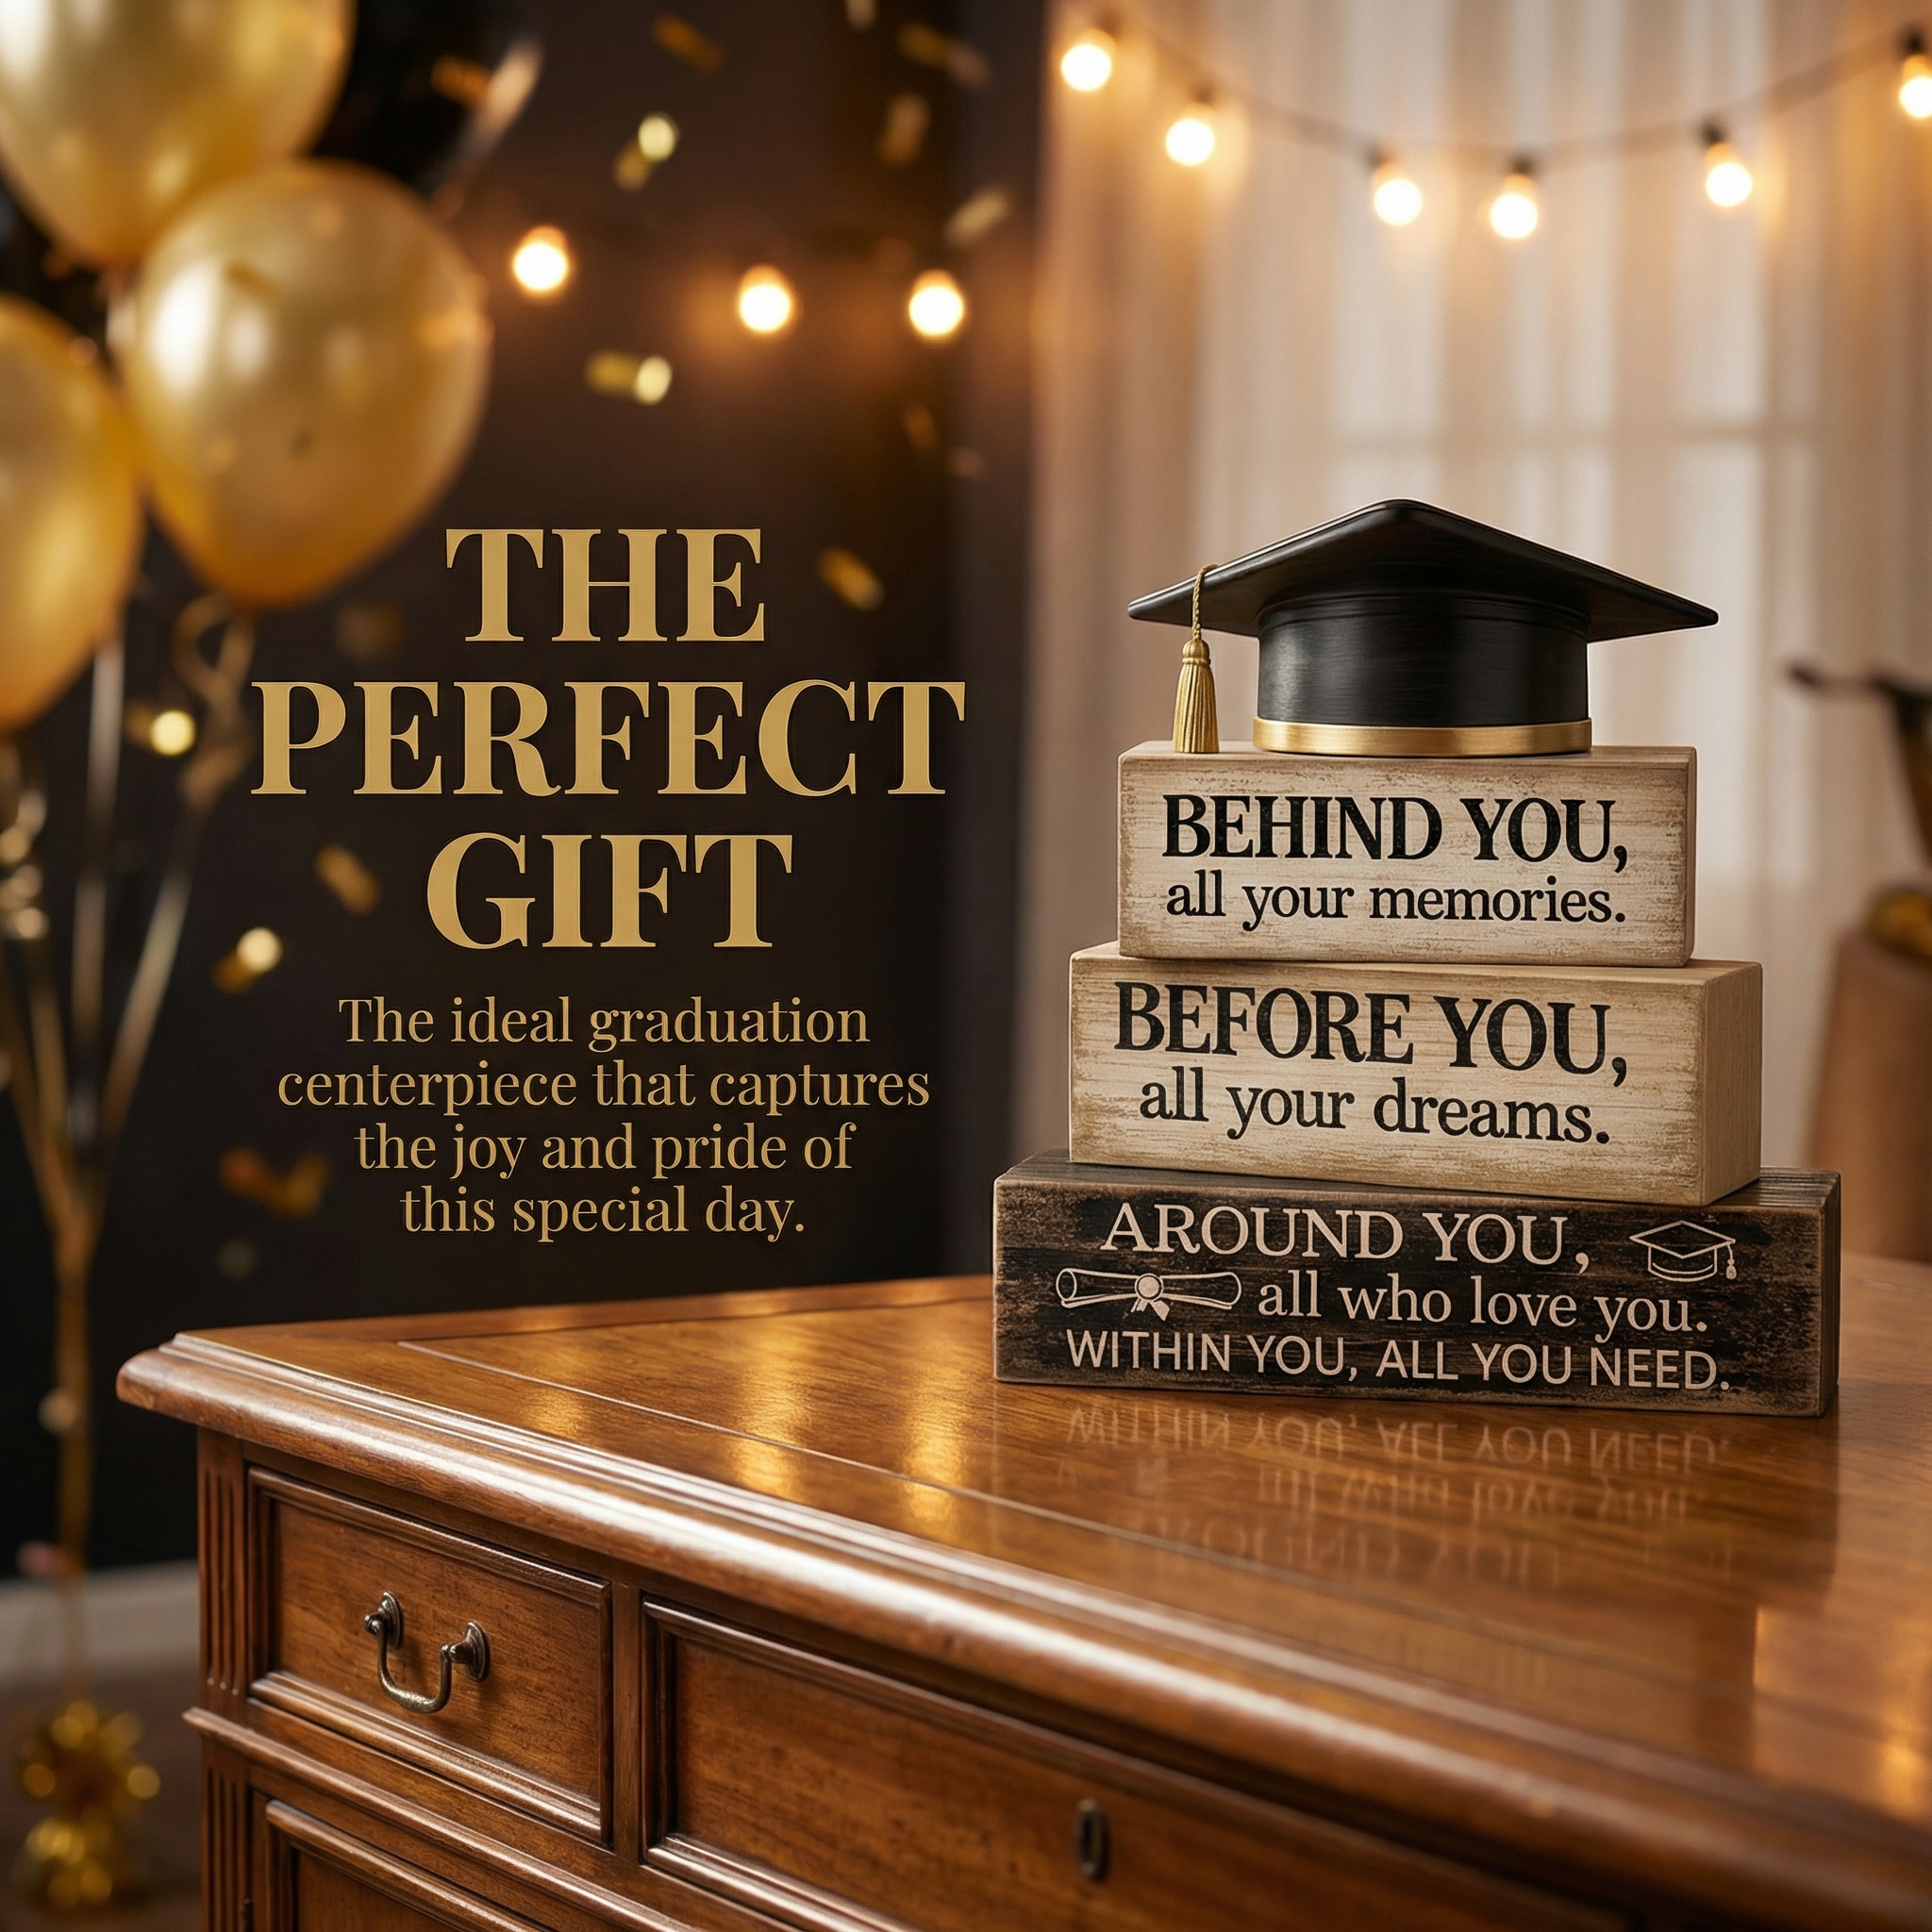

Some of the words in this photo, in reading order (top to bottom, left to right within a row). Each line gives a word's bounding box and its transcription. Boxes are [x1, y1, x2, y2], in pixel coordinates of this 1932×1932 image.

[1162, 793, 1442, 860] BEHIND
[1459, 797, 1628, 874] YOU,
[1166, 870, 1226, 919] all
[1241, 884, 1355, 932] your
[1369, 875, 1626, 924] memories.
[1113, 981, 1414, 1065] BEFORE
[1433, 995, 1627, 1088] YOU,
[1140, 1066, 1209, 1122] all
[1225, 1085, 1356, 1141] your
[1374, 1076, 1610, 1145] dreams.
[1100, 1202, 1404, 1261] AROUND
[1422, 1211, 1591, 1275] YOU,
[1257, 1269, 1321, 1318] all
[1338, 1273, 1453, 1323] who
[1471, 1275, 1577, 1327] love
[1593, 1295, 1707, 1344] you.
[1065, 1328, 1233, 1374] WITHIN
[1247, 1335, 1358, 1382] YOU,
[1376, 1341, 1458, 1380] ALL
[1477, 1343, 1573, 1385] YOU
[1589, 1347, 1730, 1392] NEED.
